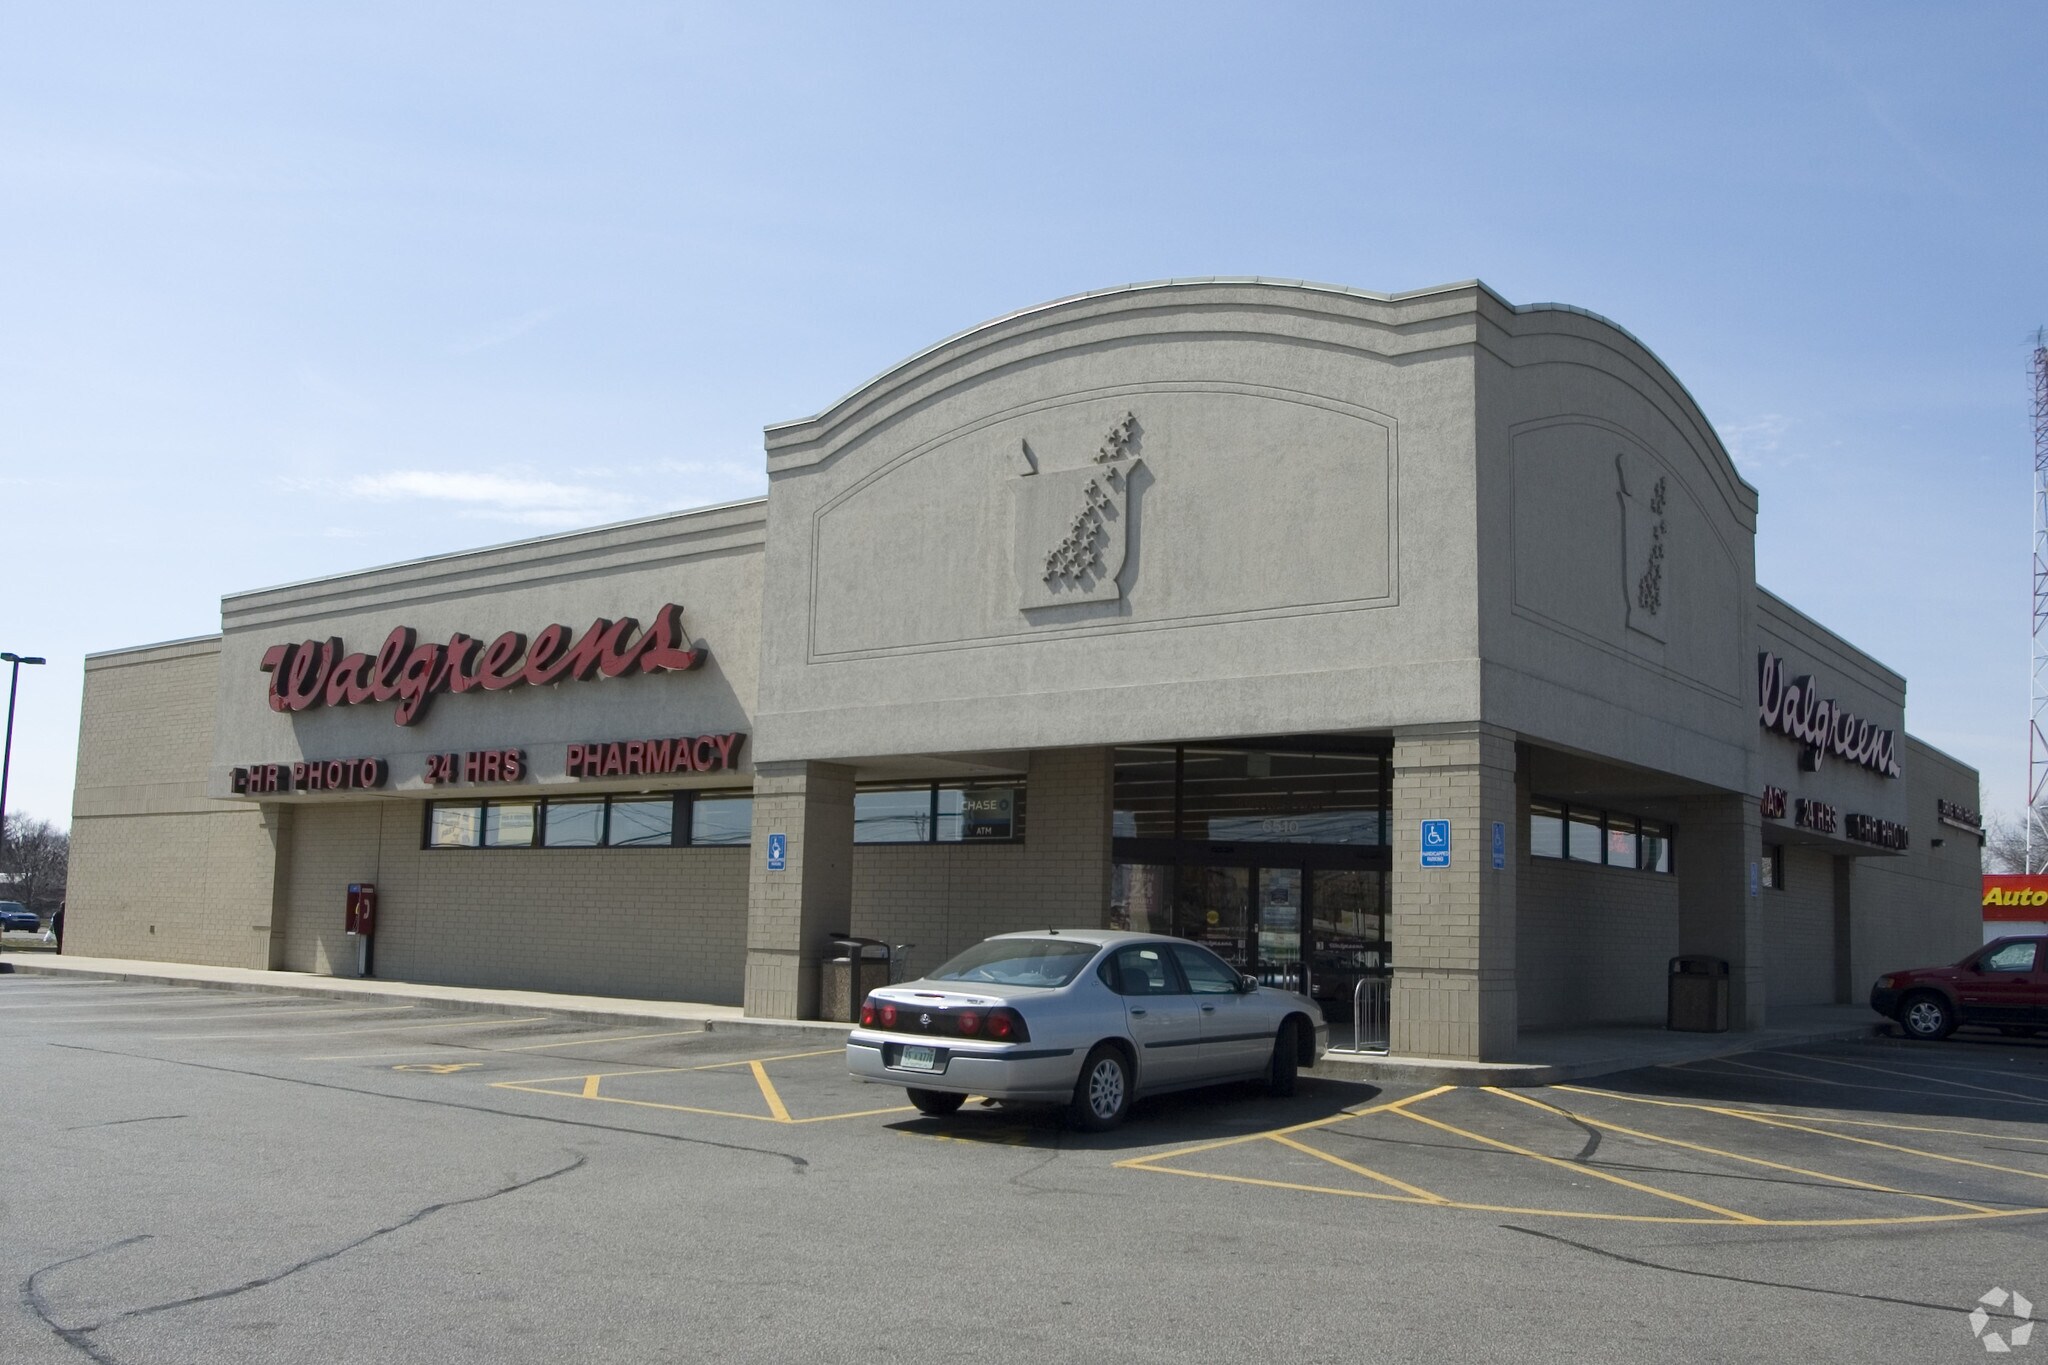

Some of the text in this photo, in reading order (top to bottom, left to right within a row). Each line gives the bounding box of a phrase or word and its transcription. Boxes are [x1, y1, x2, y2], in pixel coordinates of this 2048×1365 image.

[260, 603, 707, 727] Walgreens
[424, 748, 526, 784] 24 HRS
[566, 733, 746, 777] PHARMACY
[229, 757, 387, 793] 1-HR PHOTO
[962, 800, 997, 811] CHASE
[1818, 801, 1837, 834] HRS
[976, 826, 992, 835] ATM
[1881, 818, 1909, 850] PHOTO
[1130, 881, 1153, 897] 24
[1982, 887, 2048, 907] Auto
